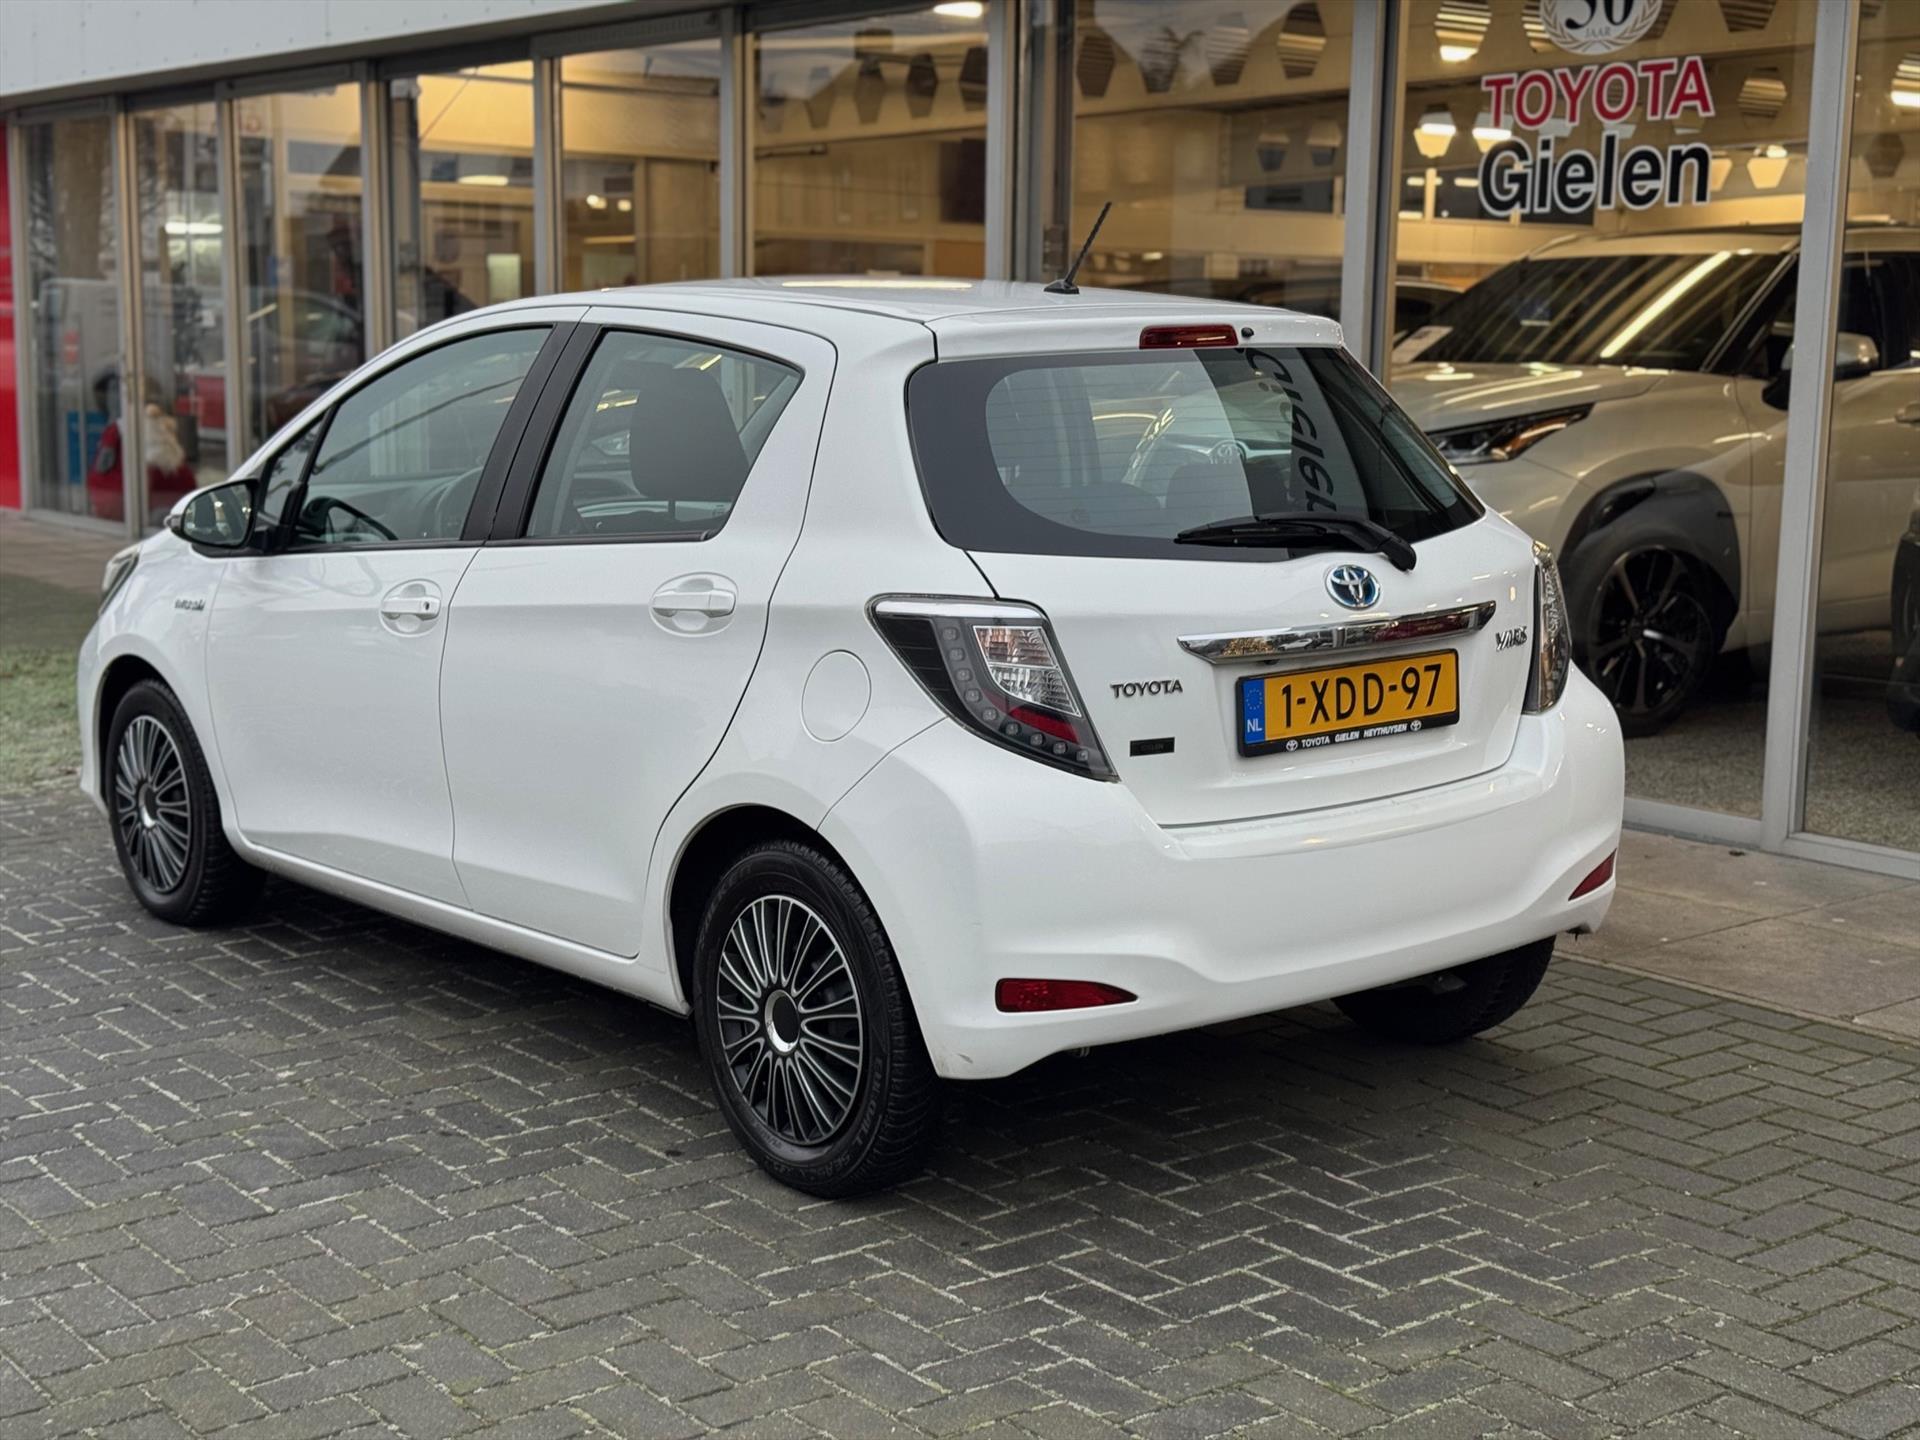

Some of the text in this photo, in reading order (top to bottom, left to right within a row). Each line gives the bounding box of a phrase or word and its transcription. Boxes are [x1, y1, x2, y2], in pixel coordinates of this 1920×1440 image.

[1585, 27, 1611, 38] JAAR
[1481, 56, 1715, 130] TOYOTA
[1478, 130, 1713, 217] Gielen
[1110, 680, 1183, 699] TOYOTA
[1281, 663, 1442, 728] 1-XDD-97
[1247, 718, 1263, 733] NL
[1301, 735, 1330, 748] TOYOTA
[1334, 730, 1360, 743] GIELEN
